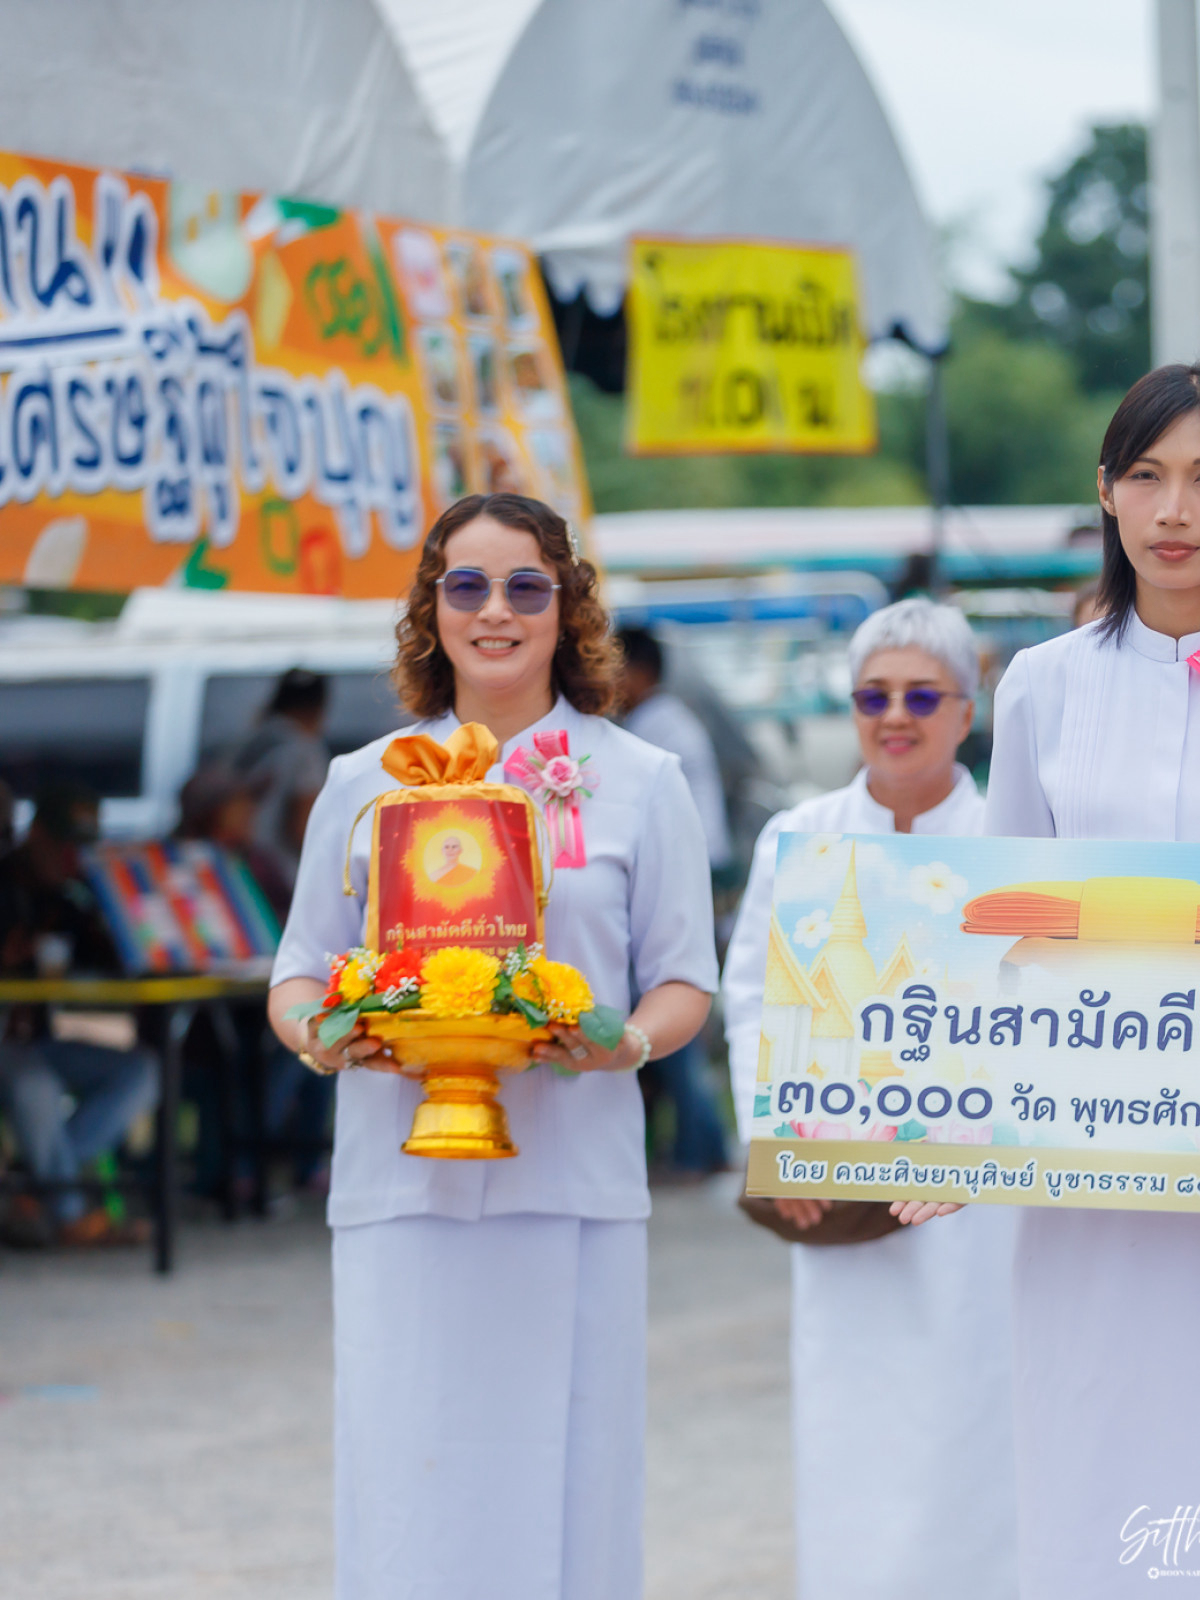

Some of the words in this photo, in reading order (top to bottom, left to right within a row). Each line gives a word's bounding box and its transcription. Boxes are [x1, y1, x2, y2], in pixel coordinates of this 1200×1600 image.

[777, 1078, 993, 1124] ๓๐,๐๐๐
[1010, 1082, 1056, 1121] วัด
[778, 1153, 825, 1181] โดย
[835, 1159, 1036, 1194] คณะศิษยานุศิษย์
[1045, 1169, 1166, 1197] บูชาธรรม
